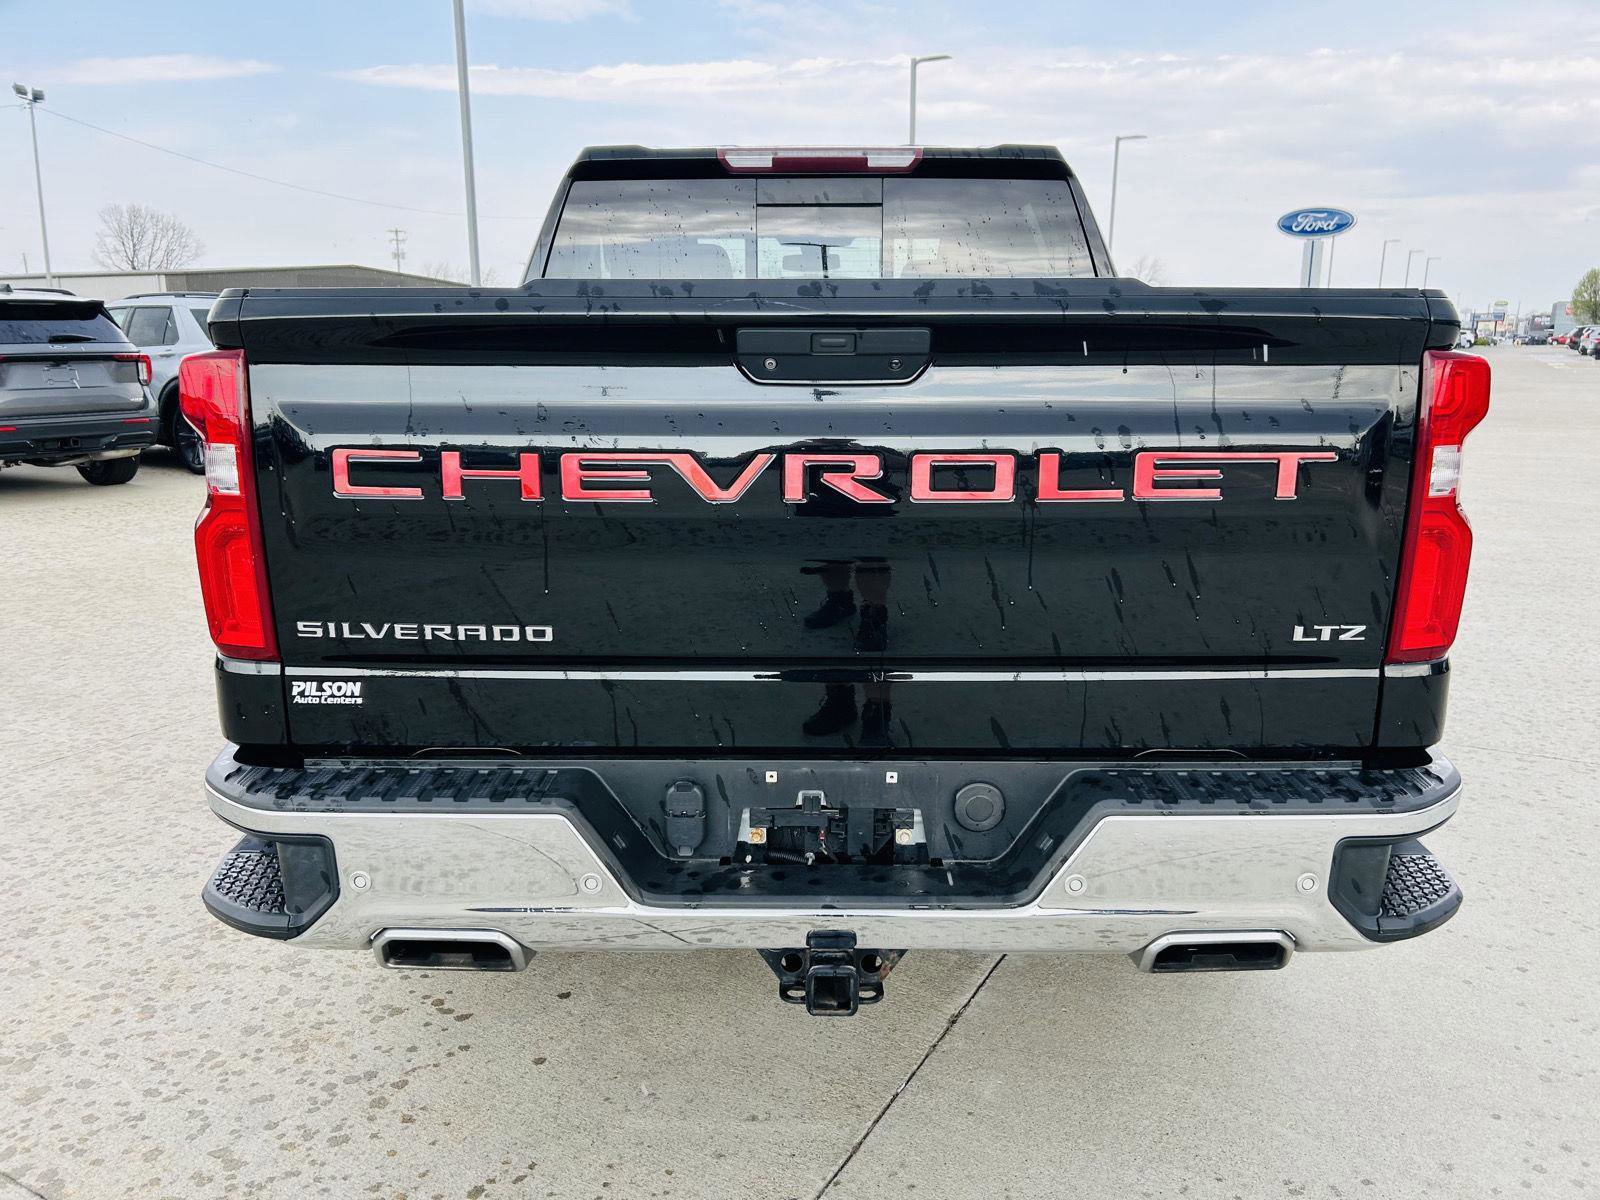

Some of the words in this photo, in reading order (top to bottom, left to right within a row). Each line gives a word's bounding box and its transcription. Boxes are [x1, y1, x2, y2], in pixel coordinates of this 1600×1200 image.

[1292, 213, 1339, 232] Ford
[332, 448, 1339, 504] CHEVROLET
[296, 621, 554, 642] SILVERADO
[1293, 625, 1367, 641] LTZ
[291, 681, 362, 696] PILSON
[293, 695, 320, 704] Auto
[321, 695, 363, 704] Centers
